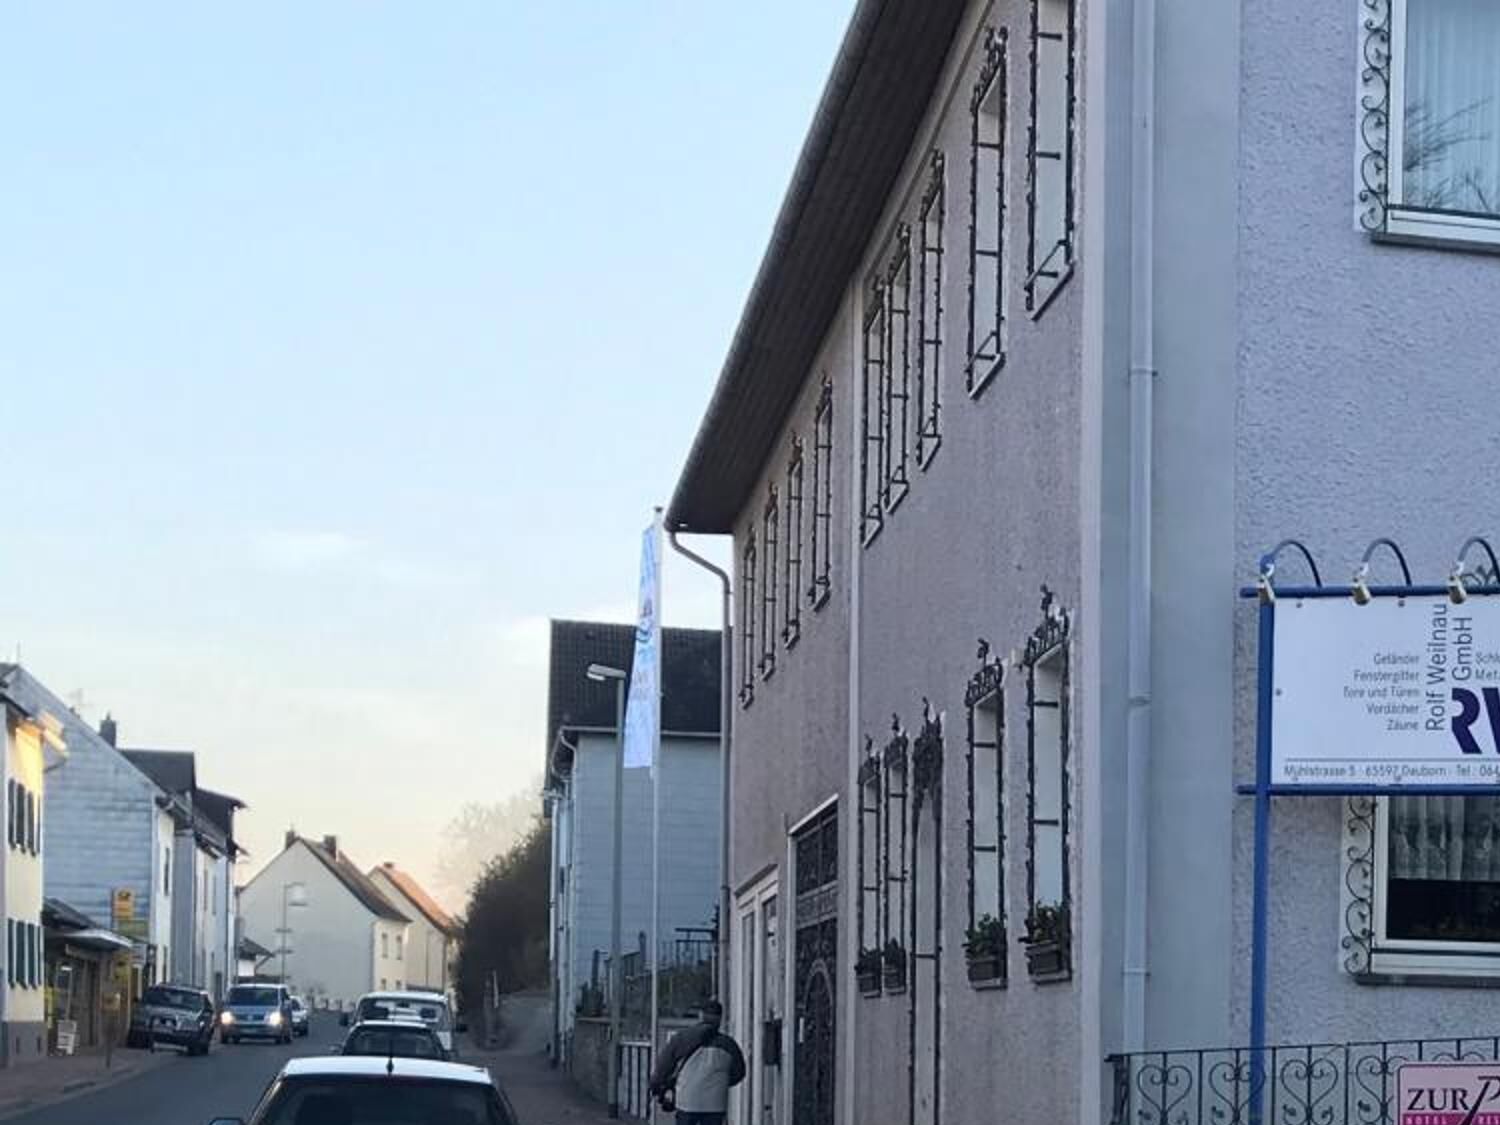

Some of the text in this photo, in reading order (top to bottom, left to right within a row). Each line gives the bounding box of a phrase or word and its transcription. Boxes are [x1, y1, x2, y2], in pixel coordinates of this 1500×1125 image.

[1451, 617, 1473, 682] GmbH
[1353, 669, 1420, 684] Fenstergitter
[1425, 603, 1448, 732] Rolf Weilnau
[1367, 686, 1388, 698] und
[1407, 1087, 1470, 1111] ZUR
[1407, 1115, 1448, 1125] HOTEL
